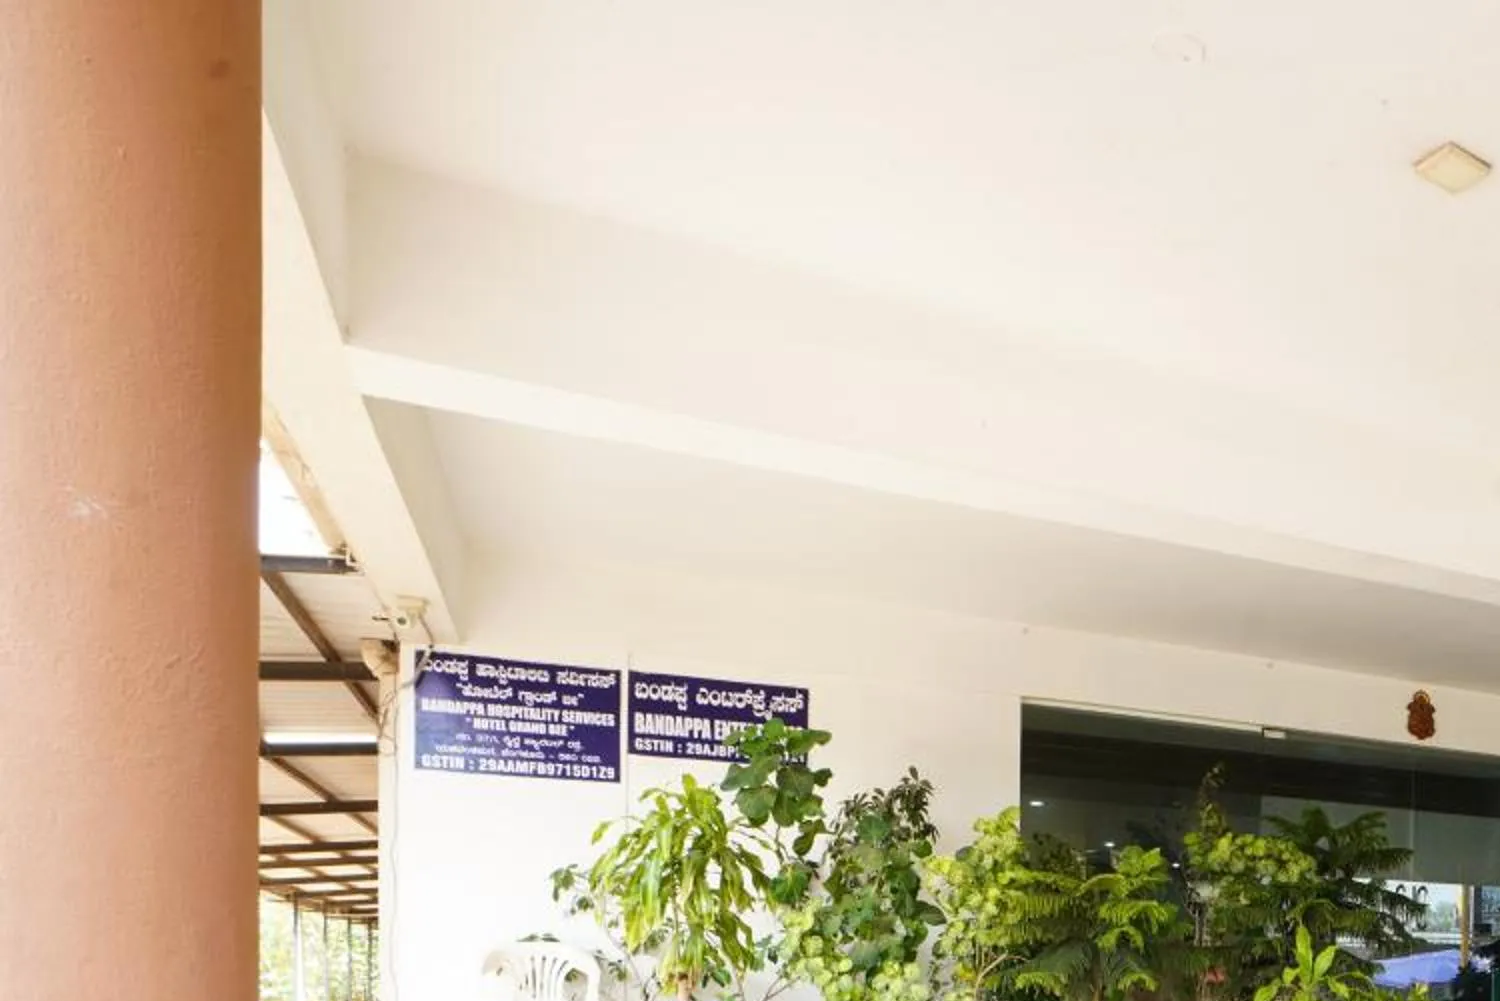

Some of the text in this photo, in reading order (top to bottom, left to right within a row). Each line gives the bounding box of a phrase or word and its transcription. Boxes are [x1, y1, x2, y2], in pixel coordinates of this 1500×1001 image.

[421, 697, 616, 727] BANDAPPA HOSPITALITY SERVICES
[508, 721, 547, 735] GRAND
[634, 711, 711, 740] BANDAPPA
[634, 740, 673, 753] GSTIN
[421, 753, 465, 770] GSTIN
